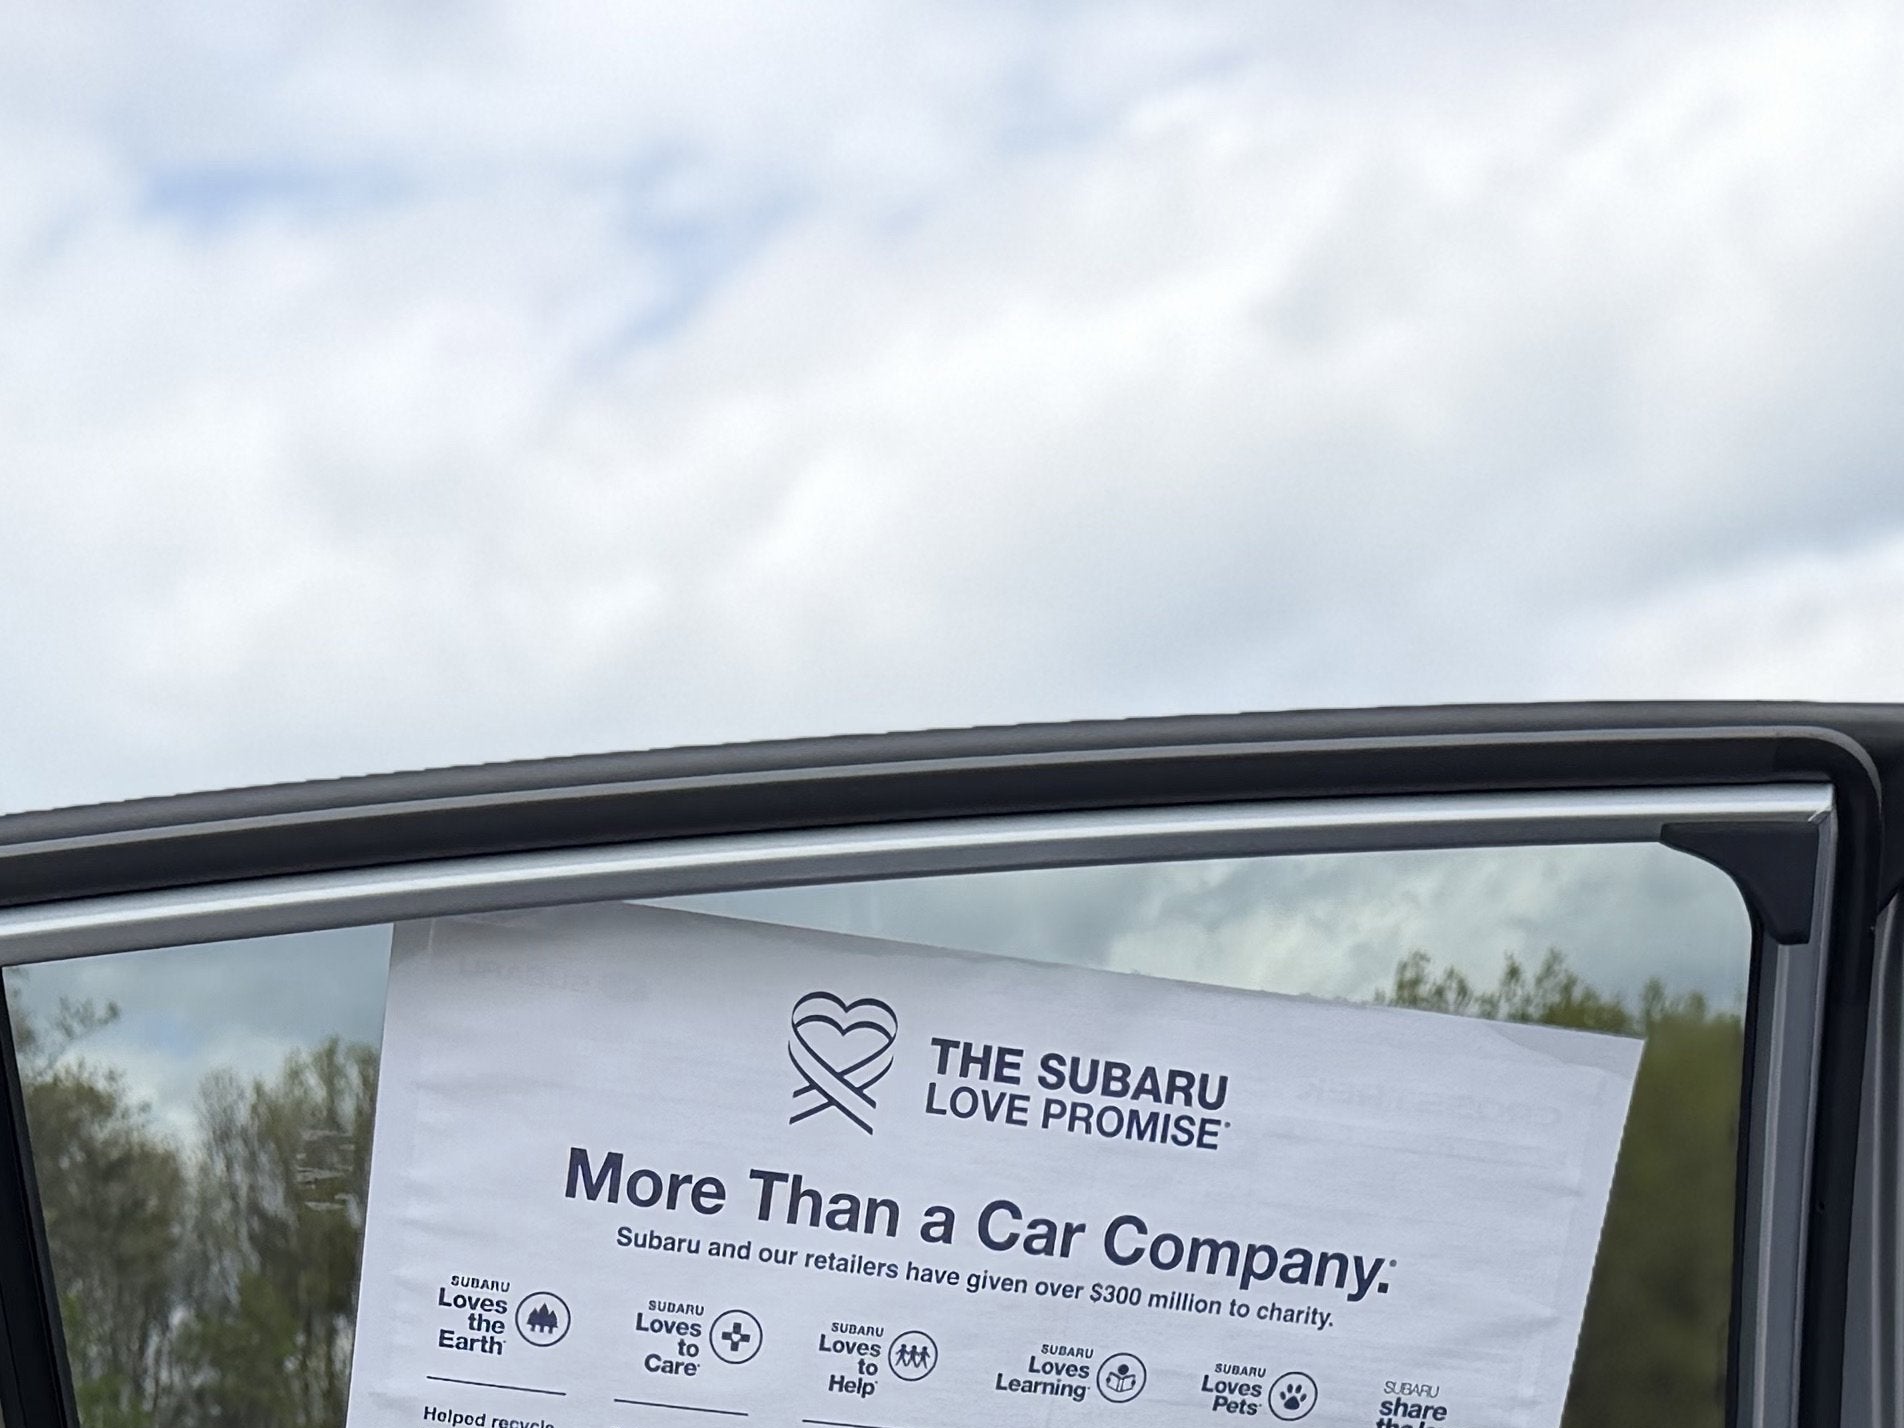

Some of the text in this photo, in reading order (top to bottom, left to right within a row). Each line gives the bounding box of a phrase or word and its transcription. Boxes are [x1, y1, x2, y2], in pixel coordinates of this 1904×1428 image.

[930, 1037, 1024, 1086] THE
[1037, 1052, 1228, 1111] SUBARU
[925, 1082, 1031, 1127] LOVE
[564, 1146, 726, 1215] More
[749, 1168, 900, 1238] Than
[920, 1205, 956, 1245] a
[977, 1199, 1087, 1258] Car
[450, 1275, 510, 1293] SUBARU
[616, 1226, 1334, 1331] Subaru and our retailers have given over $300 million to charity.
[438, 1287, 507, 1314] Loves
[648, 1300, 704, 1316] SUBARU
[467, 1312, 506, 1335] the
[635, 1312, 702, 1338] Loves
[830, 1322, 884, 1338] SUBARU
[677, 1338, 700, 1358] to
[818, 1333, 882, 1358] Loves
[1040, 1344, 1094, 1359] SUBARU
[856, 1358, 879, 1376] to
[1028, 1353, 1091, 1380] Loves
[1214, 1362, 1267, 1378] SUBARU
[1201, 1374, 1263, 1398] Loves
[1383, 1380, 1440, 1399] SUBARU
[423, 1406, 486, 1427] Helped
[1378, 1396, 1447, 1422] share
